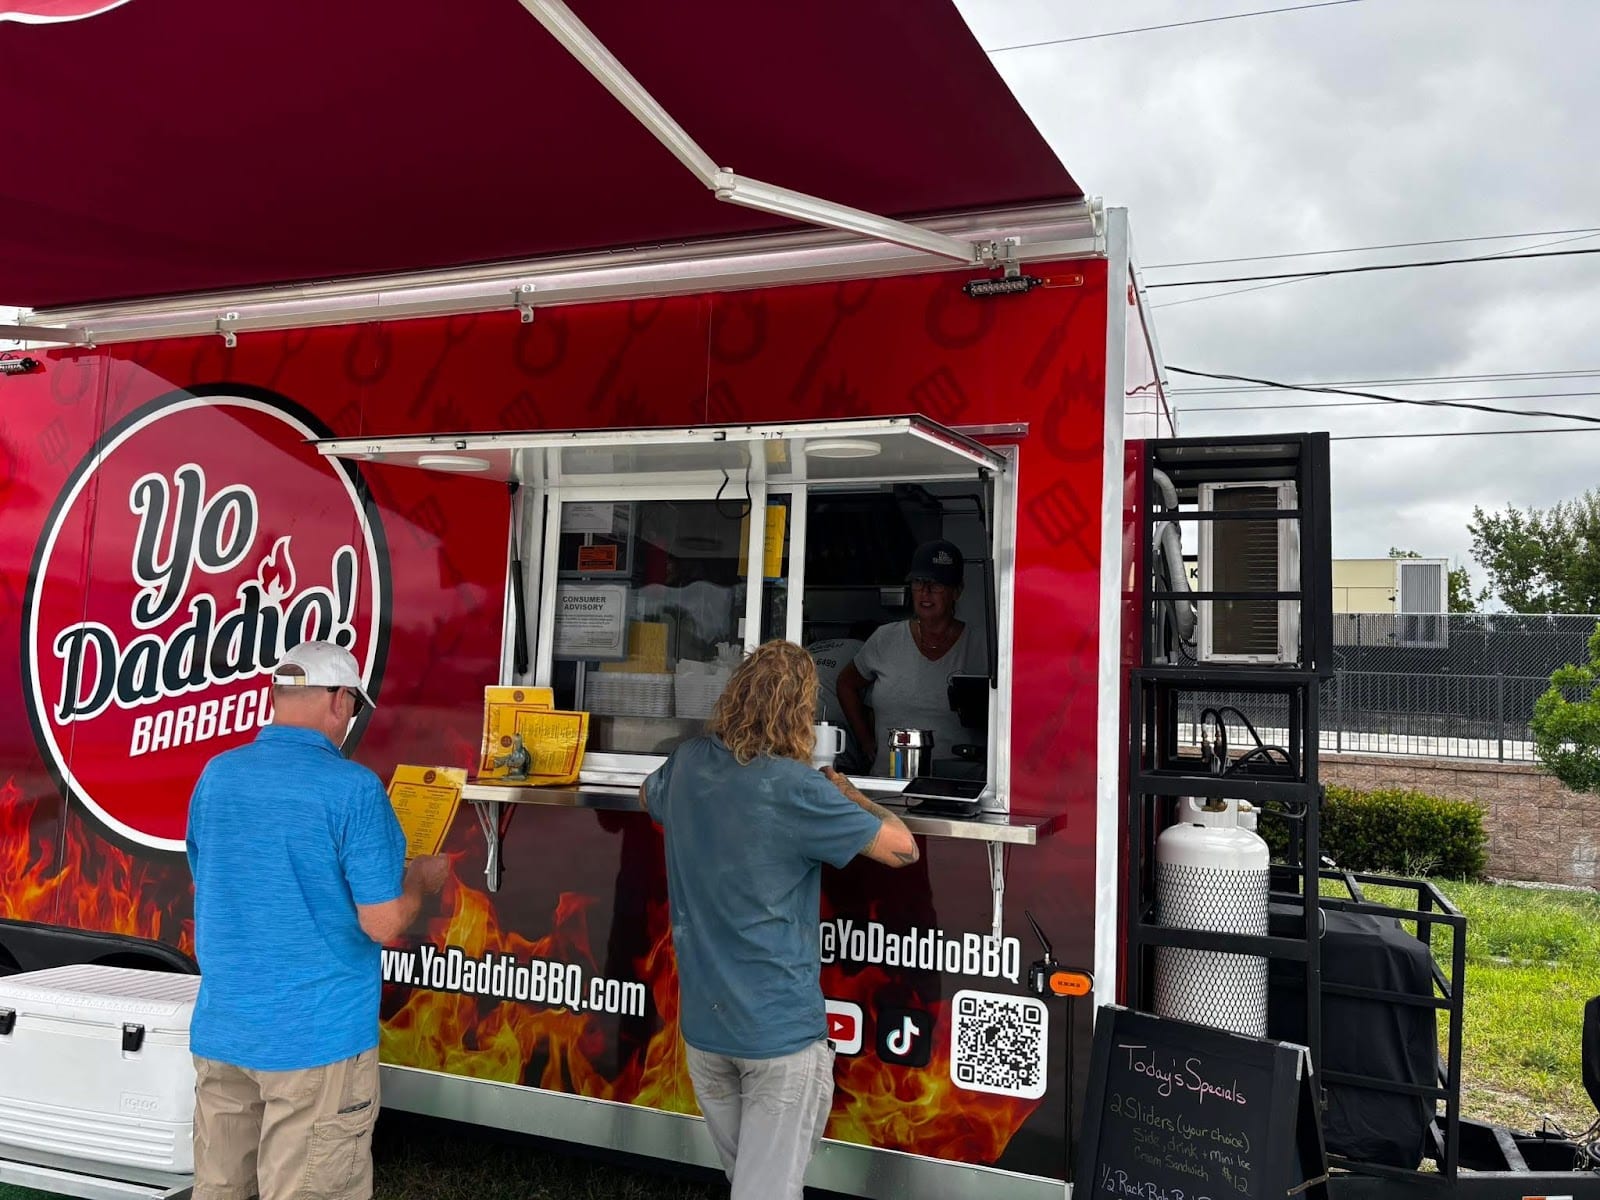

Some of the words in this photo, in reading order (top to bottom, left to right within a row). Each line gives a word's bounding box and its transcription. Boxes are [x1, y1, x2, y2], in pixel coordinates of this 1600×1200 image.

[129, 463, 258, 630] Yo
[54, 545, 357, 725] Daddio!
[564, 603, 604, 611] ADVISORY
[130, 686, 275, 757] BARBECU
[381, 945, 646, 1017] ww.YoDaddioBBQ.com
[819, 918, 1020, 984] @YoDaddioBBQ
[1118, 1044, 1184, 1097] Today's
[1185, 1058, 1247, 1104] Specials
[1110, 1093, 1122, 1117] 2
[1124, 1097, 1175, 1132] Sliders
[1164, 1154, 1209, 1182] Sandwich
[1167, 1136, 1199, 1160] drink
[1114, 1169, 1145, 1197] Rack
